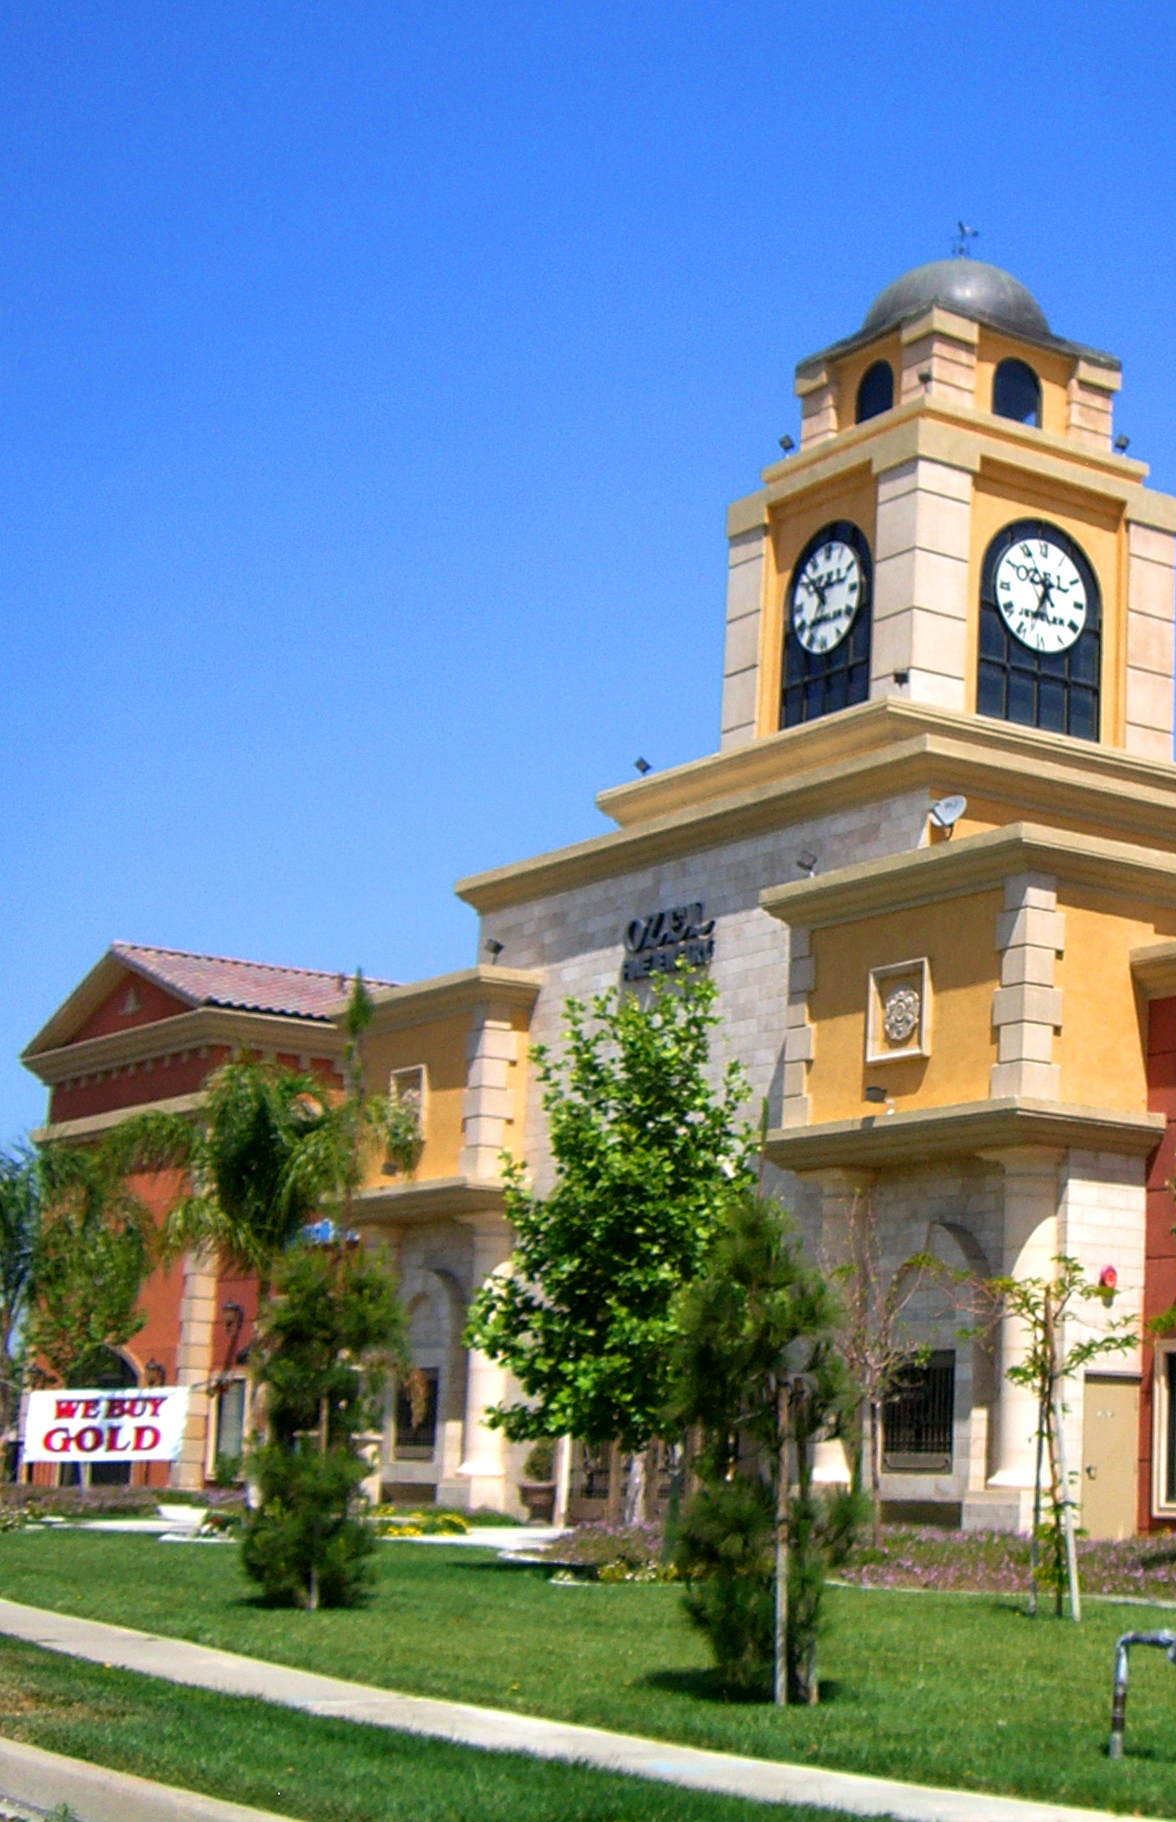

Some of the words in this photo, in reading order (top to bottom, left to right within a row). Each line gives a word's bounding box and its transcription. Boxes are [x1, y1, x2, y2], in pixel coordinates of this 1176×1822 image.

[1016, 565, 1069, 594] OZEL
[54, 1399, 101, 1420] WE
[105, 1396, 168, 1418] BUY
[42, 1425, 162, 1454] GOLD
